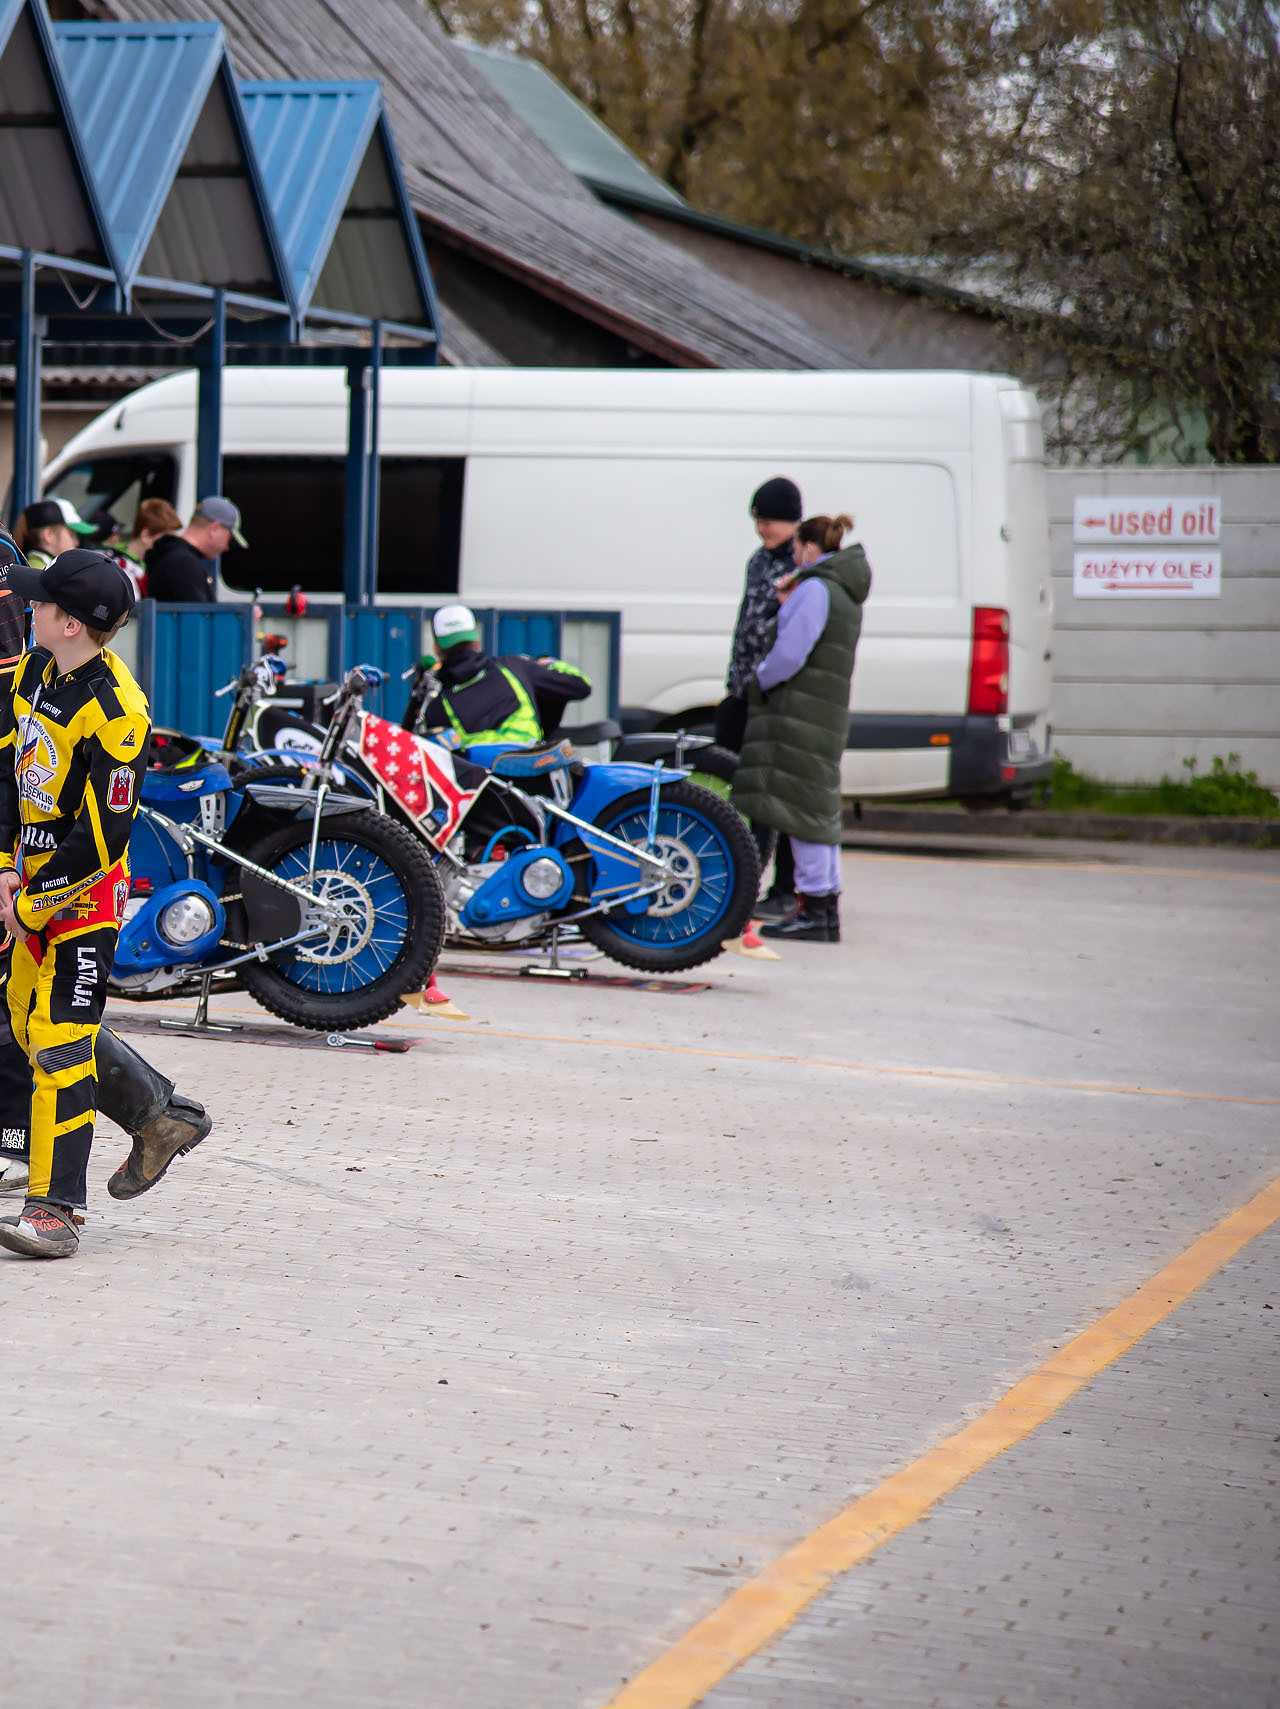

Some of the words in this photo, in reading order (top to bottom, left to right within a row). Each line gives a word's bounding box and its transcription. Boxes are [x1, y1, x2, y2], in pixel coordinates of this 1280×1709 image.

[1109, 504, 1173, 536] used
[1181, 504, 1216, 536] oil
[1162, 561, 1213, 579] OLEJ
[23, 782, 53, 805] USEKLIS
[41, 875, 69, 891] FACTORY
